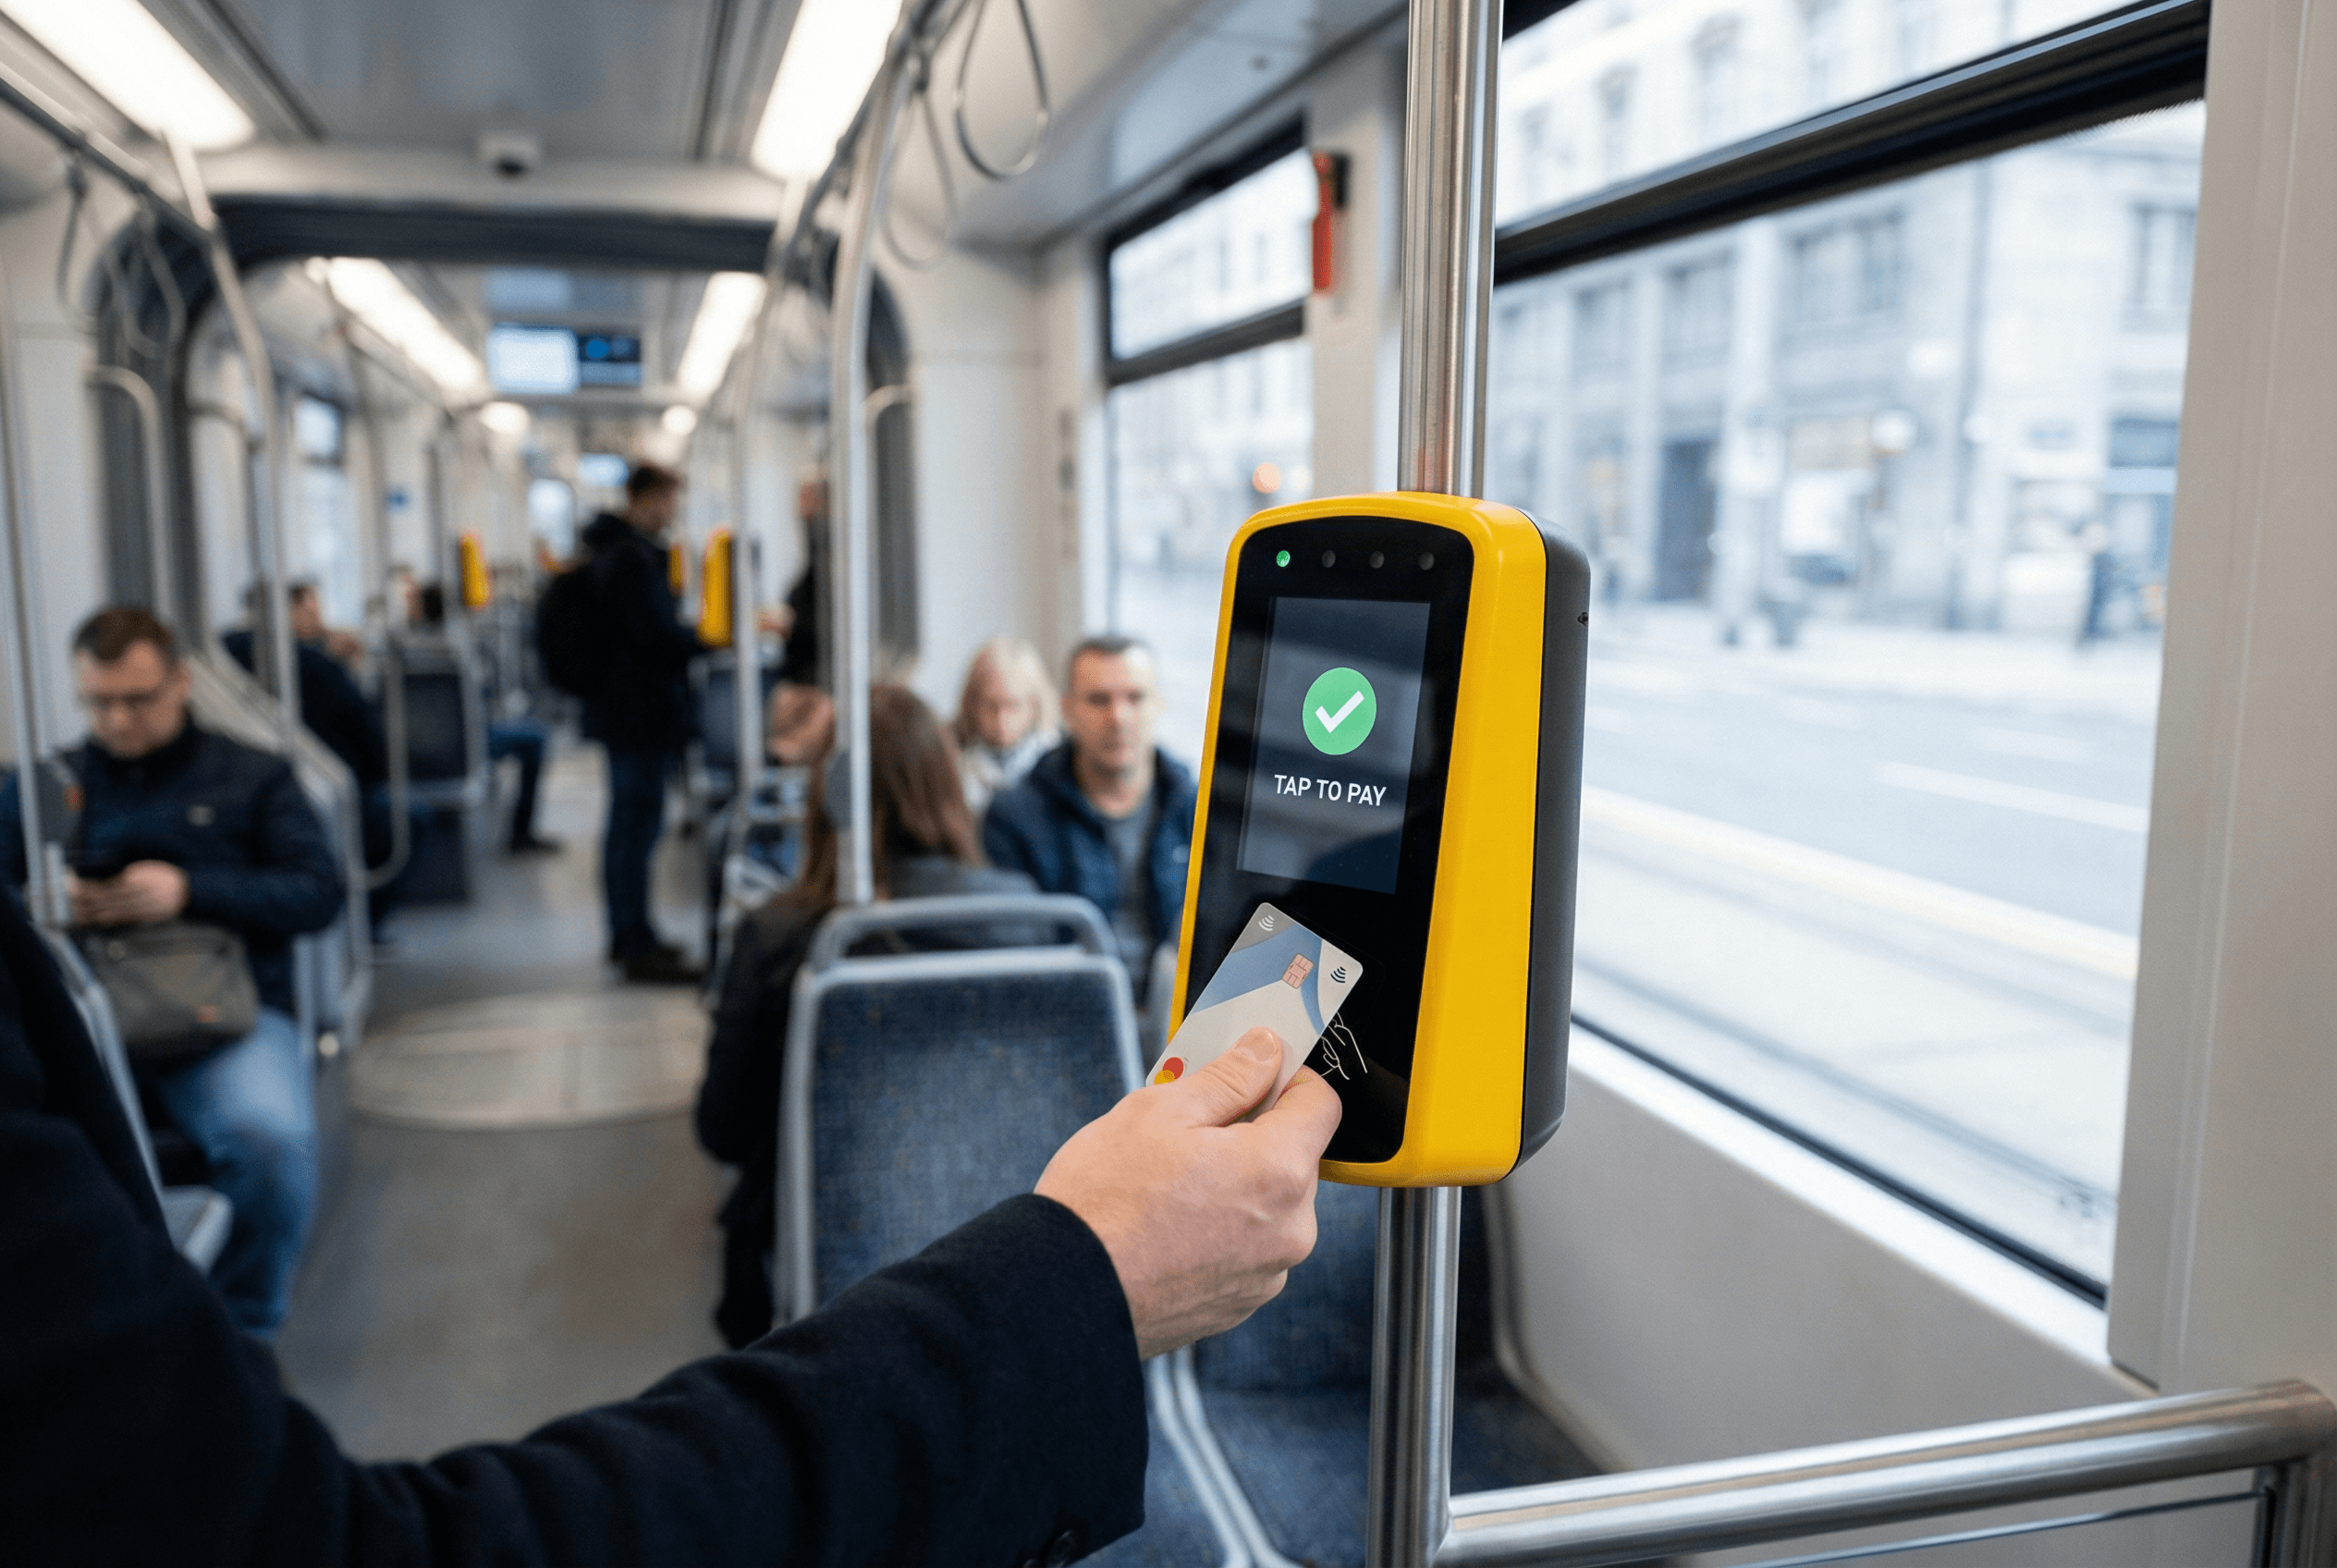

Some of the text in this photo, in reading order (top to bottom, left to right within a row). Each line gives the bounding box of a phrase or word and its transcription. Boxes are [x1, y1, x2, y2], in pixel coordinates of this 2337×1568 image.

[1274, 774, 1387, 806] TAP TO PAY
